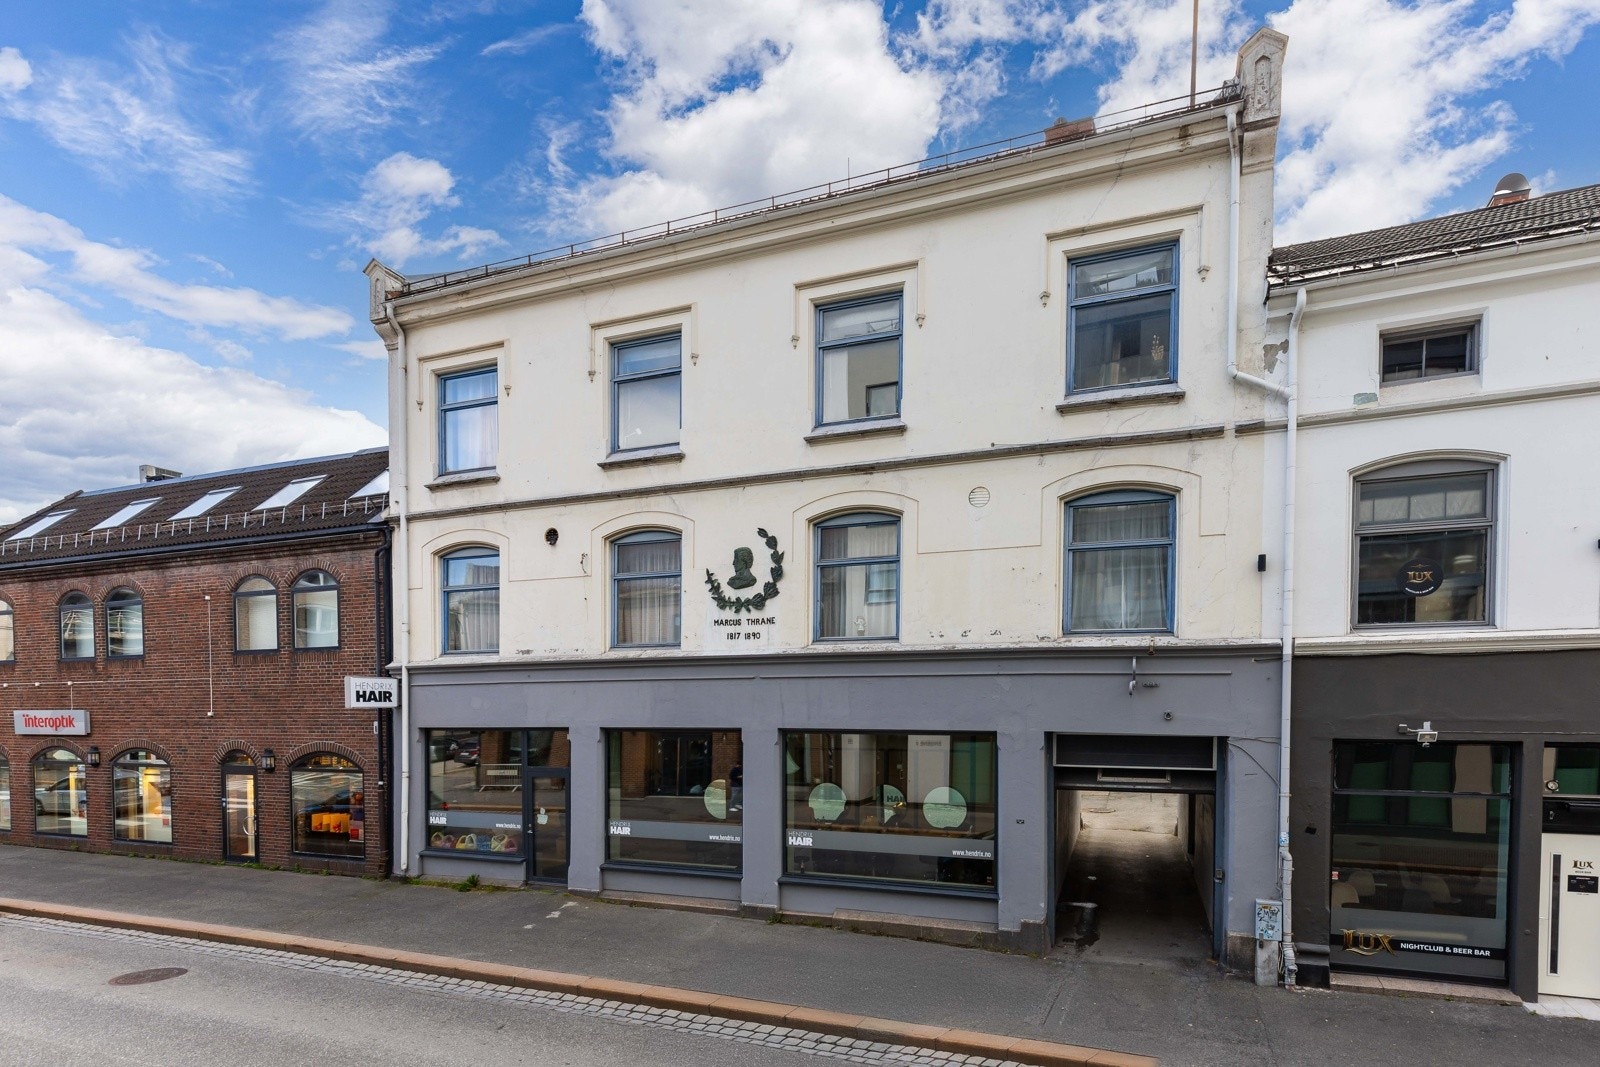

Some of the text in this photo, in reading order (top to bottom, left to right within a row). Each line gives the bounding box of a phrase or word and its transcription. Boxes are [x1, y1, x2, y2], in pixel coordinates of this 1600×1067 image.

[1407, 571, 1433, 583] LUX
[746, 616, 776, 626] THRANE
[726, 631, 761, 640] 1817 1890
[354, 681, 393, 691] HENDRIX
[355, 690, 393, 703] HAIR
[429, 816, 447, 825] HAIR
[610, 825, 631, 835] HAIR
[788, 836, 813, 846] HAIR
[952, 849, 992, 858] www.hendrix.no
[1572, 860, 1594, 870] LUX
[1340, 928, 1398, 957] LUX
[1400, 942, 1444, 952] NIGHTCLUB
[1453, 947, 1473, 955] BEER
[1474, 949, 1491, 957] BAR
